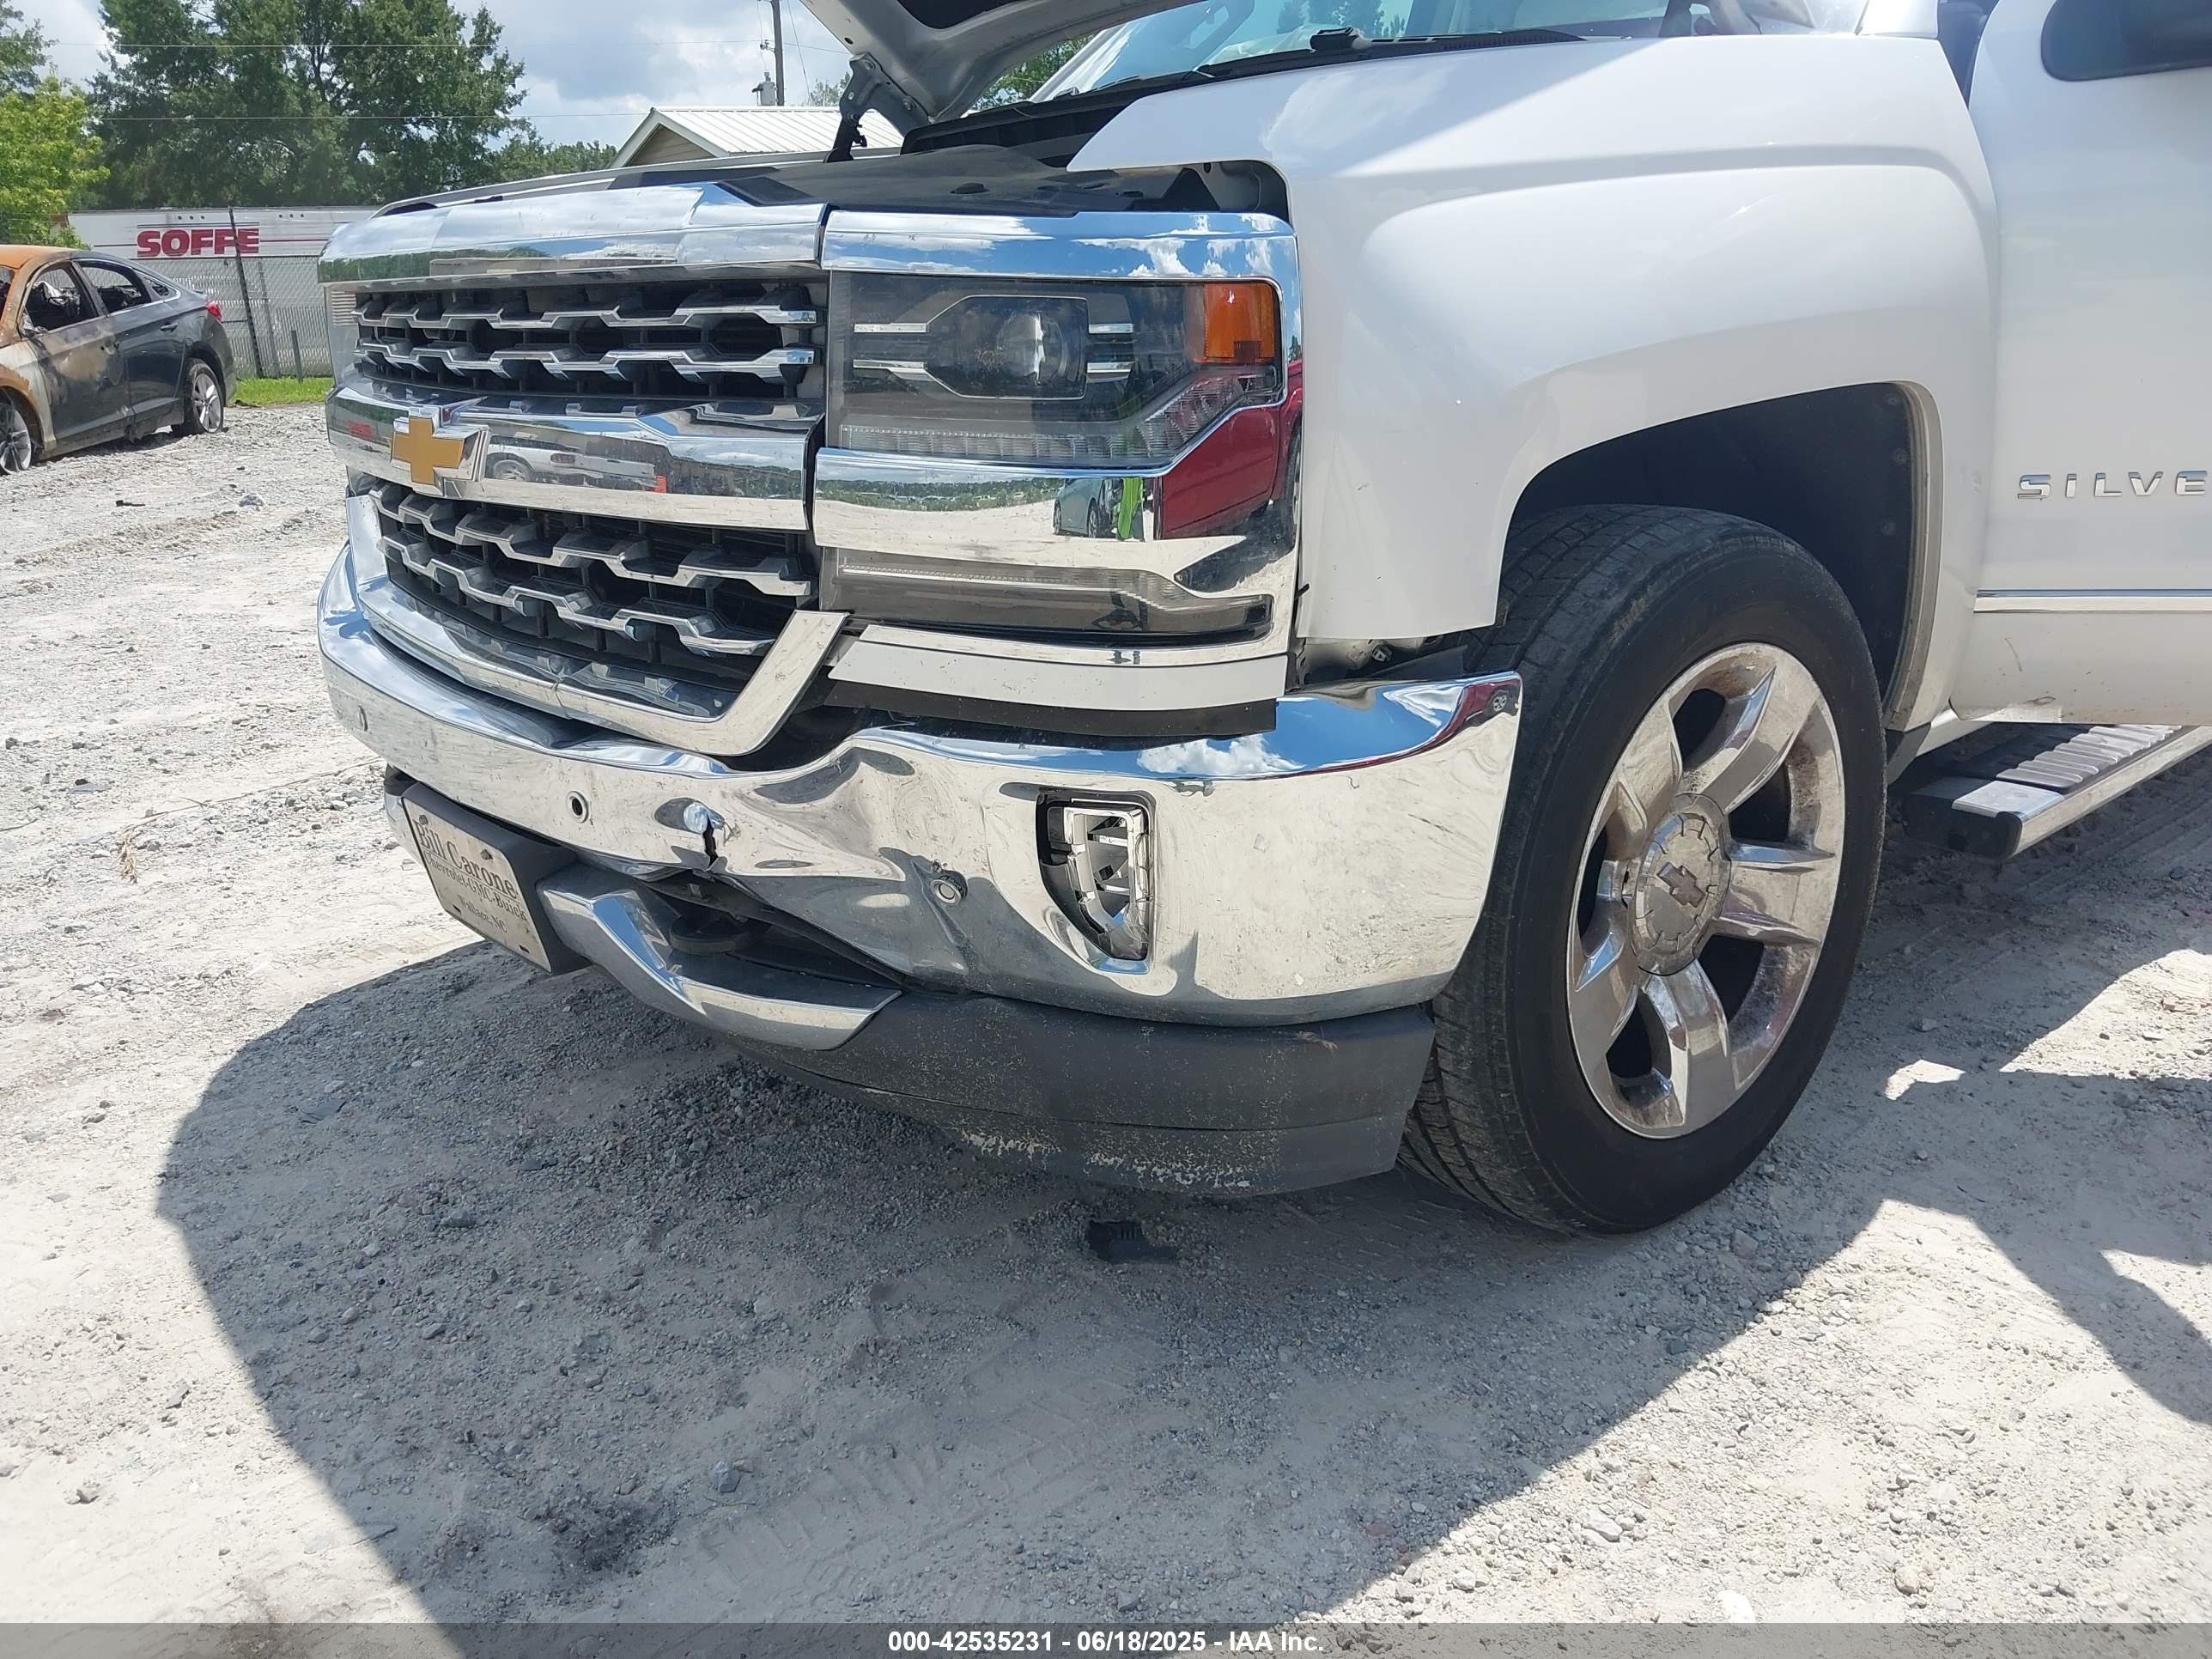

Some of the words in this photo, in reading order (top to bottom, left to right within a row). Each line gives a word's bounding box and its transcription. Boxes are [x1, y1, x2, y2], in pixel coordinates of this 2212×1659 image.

[137, 228, 259, 257] SOFFE
[2017, 470, 2208, 501] SILVE
[412, 820, 447, 860] Bill
[448, 842, 518, 899] Carone
[492, 914, 507, 933] NC
